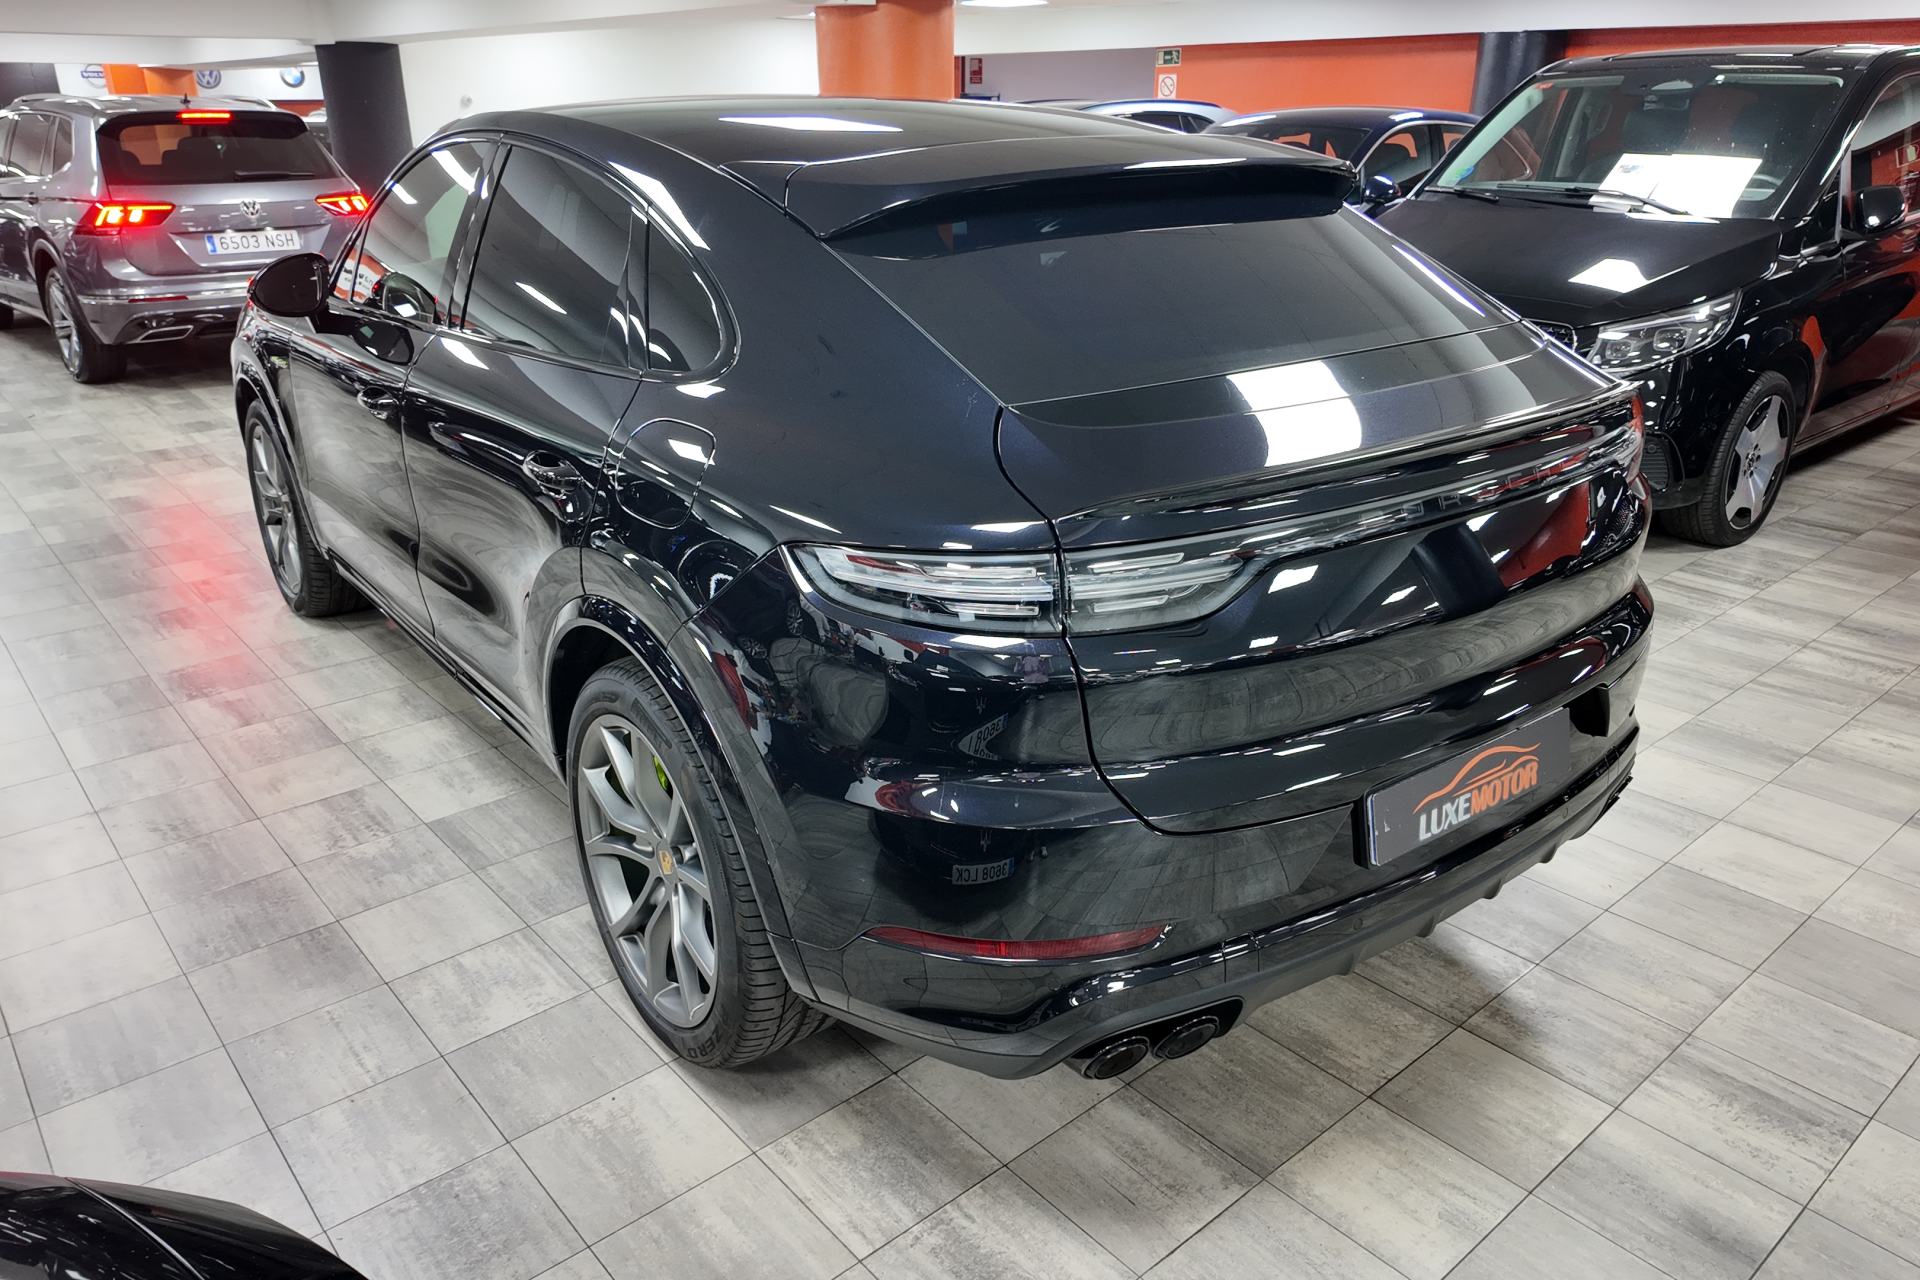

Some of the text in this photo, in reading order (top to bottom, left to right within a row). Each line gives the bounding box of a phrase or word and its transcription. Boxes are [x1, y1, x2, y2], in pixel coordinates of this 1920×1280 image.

[219, 233, 296, 250] 6503 NSH
[1418, 761, 1539, 842] LUXEMOTOR
